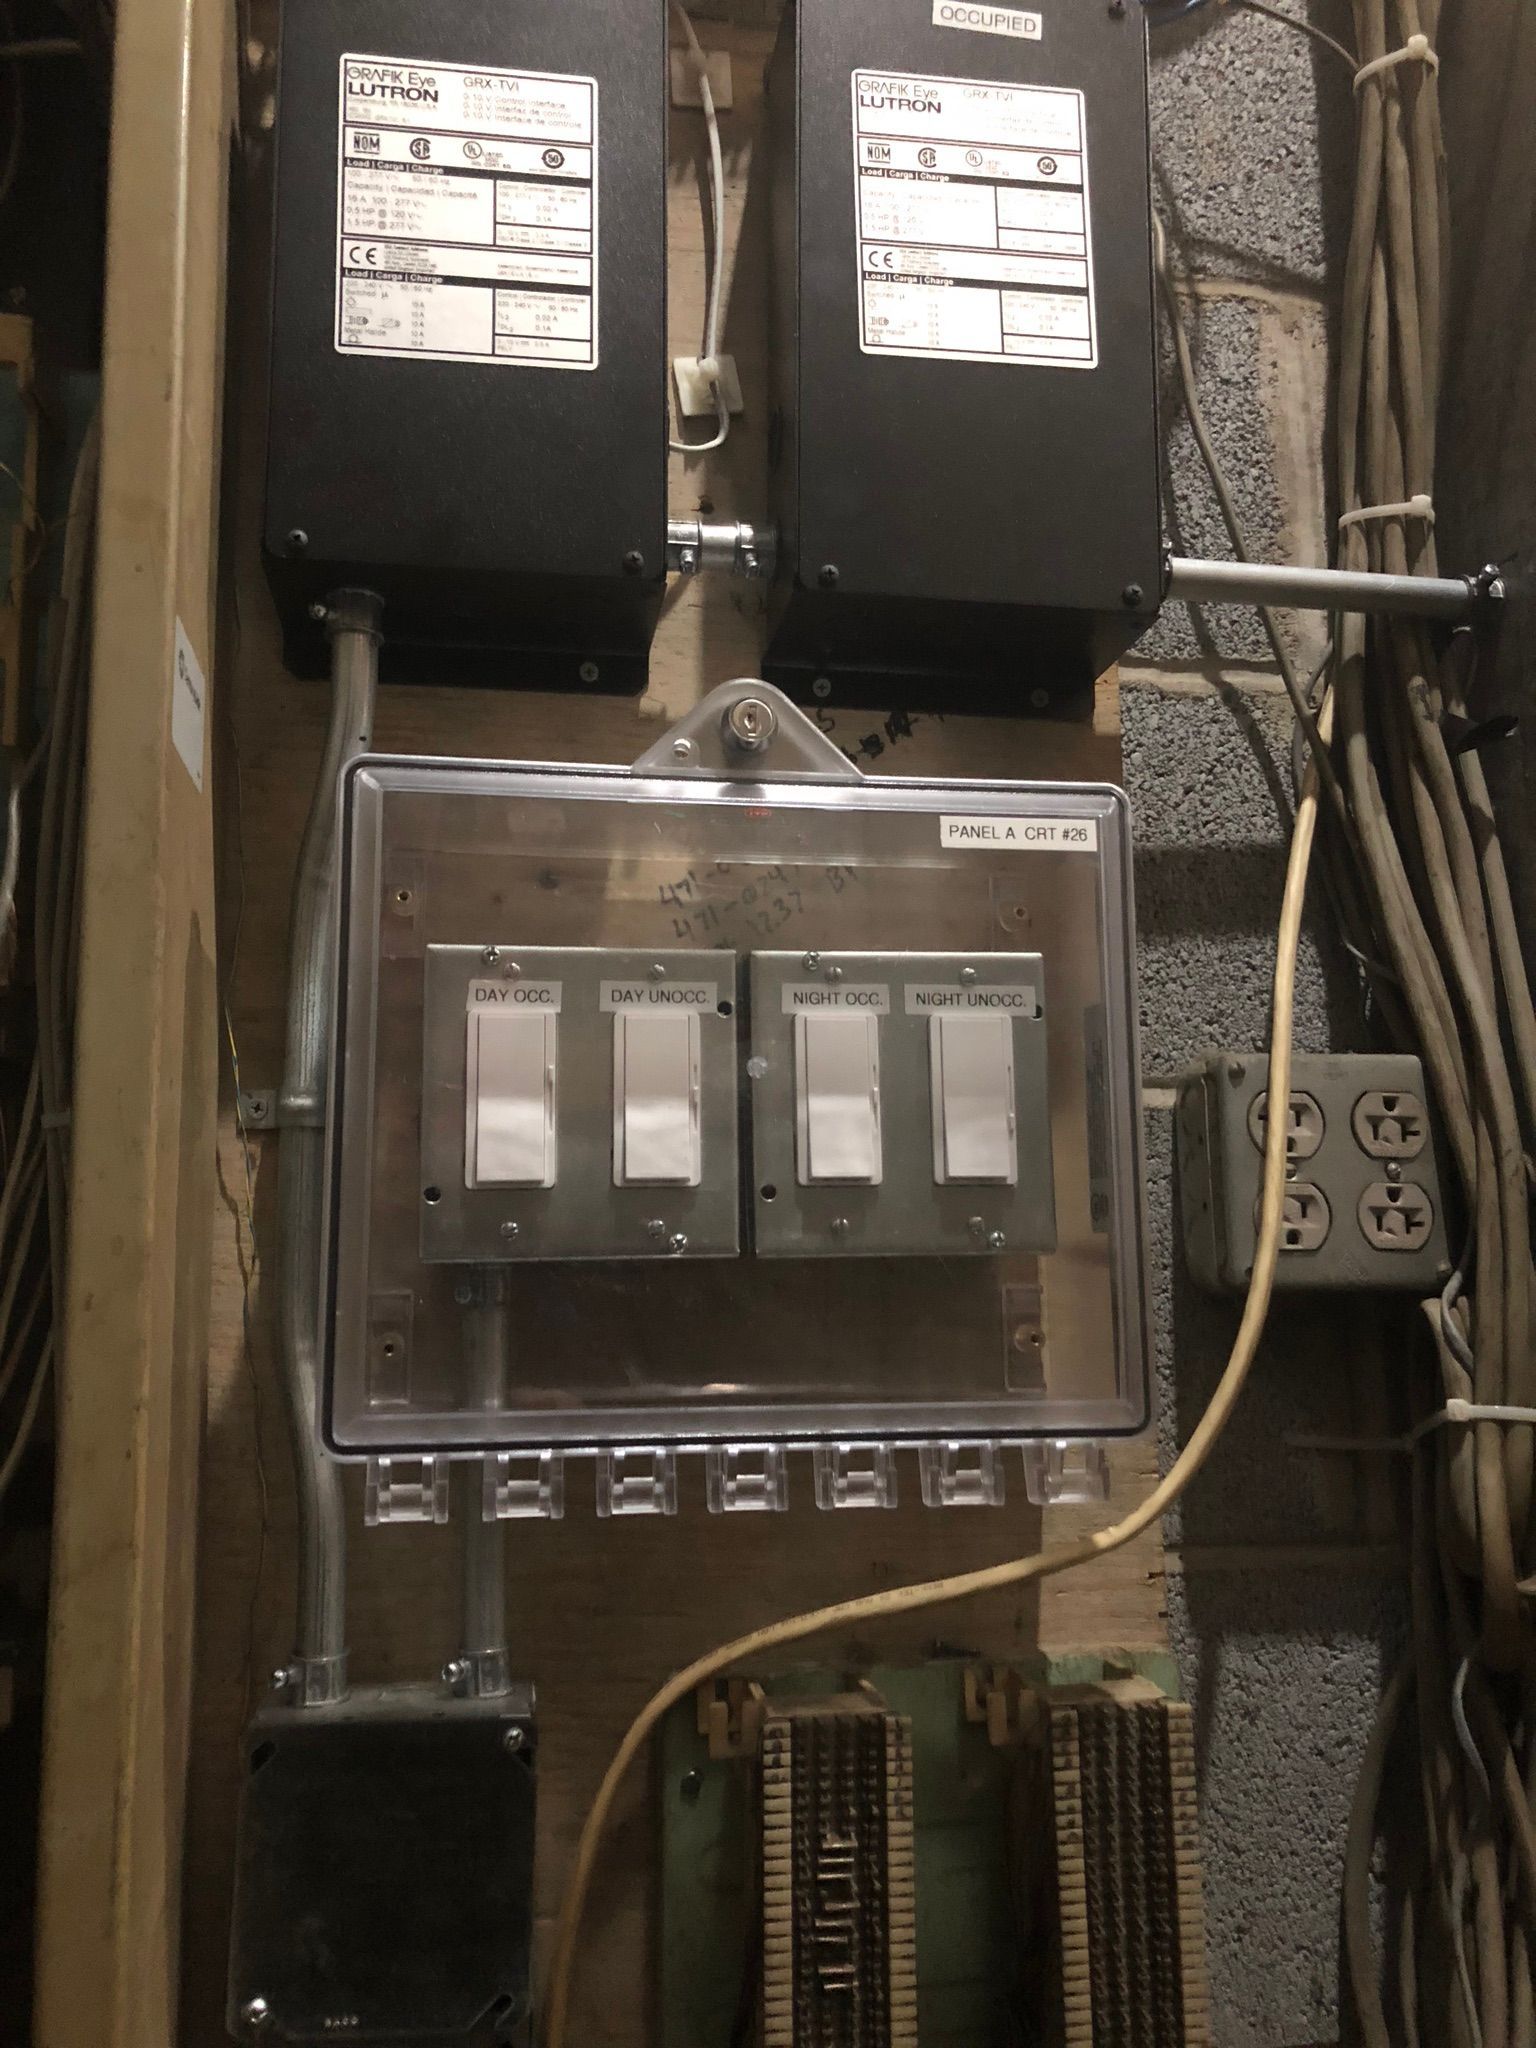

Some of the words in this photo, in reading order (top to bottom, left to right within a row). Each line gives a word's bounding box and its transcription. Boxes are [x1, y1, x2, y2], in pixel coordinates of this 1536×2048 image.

[940, 5, 1036, 33] OCCUPIED
[347, 66, 403, 84] GRAFIK
[408, 71, 437, 89] Eye
[463, 76, 519, 92] GRX-TVI
[348, 81, 439, 103] LUTRON
[858, 79, 909, 96] GRAFIK
[913, 84, 939, 101] Eye
[860, 94, 942, 114] LUTRON
[353, 136, 380, 151] NOM
[867, 145, 891, 161] NOM
[347, 159, 370, 168] Load
[377, 161, 404, 171] Carga
[411, 164, 444, 175] Charge
[861, 168, 883, 177] Load
[889, 170, 914, 180] Carga
[920, 172, 950, 183] Charge
[349, 246, 377, 266] CE
[868, 250, 893, 269] CE
[345, 269, 368, 278] Load
[375, 272, 403, 283] Carga
[410, 274, 443, 285] Charge
[865, 272, 887, 281] Load
[893, 275, 918, 284] Carga
[924, 277, 954, 287] Charge
[949, 824, 1001, 840] PANEL
[1005, 826, 1016, 840] A
[1024, 826, 1057, 840] CRT
[1062, 828, 1088, 842] #26
[475, 988, 509, 1003] DAY
[513, 989, 555, 1003] OCC.
[611, 988, 645, 1003] DAY
[648, 989, 711, 1004] UNOCC.
[793, 991, 841, 1005] NIGHT
[845, 991, 884, 1006] OCC.
[915, 992, 963, 1006] NIGHT
[967, 992, 1027, 1007] UNOCC.
